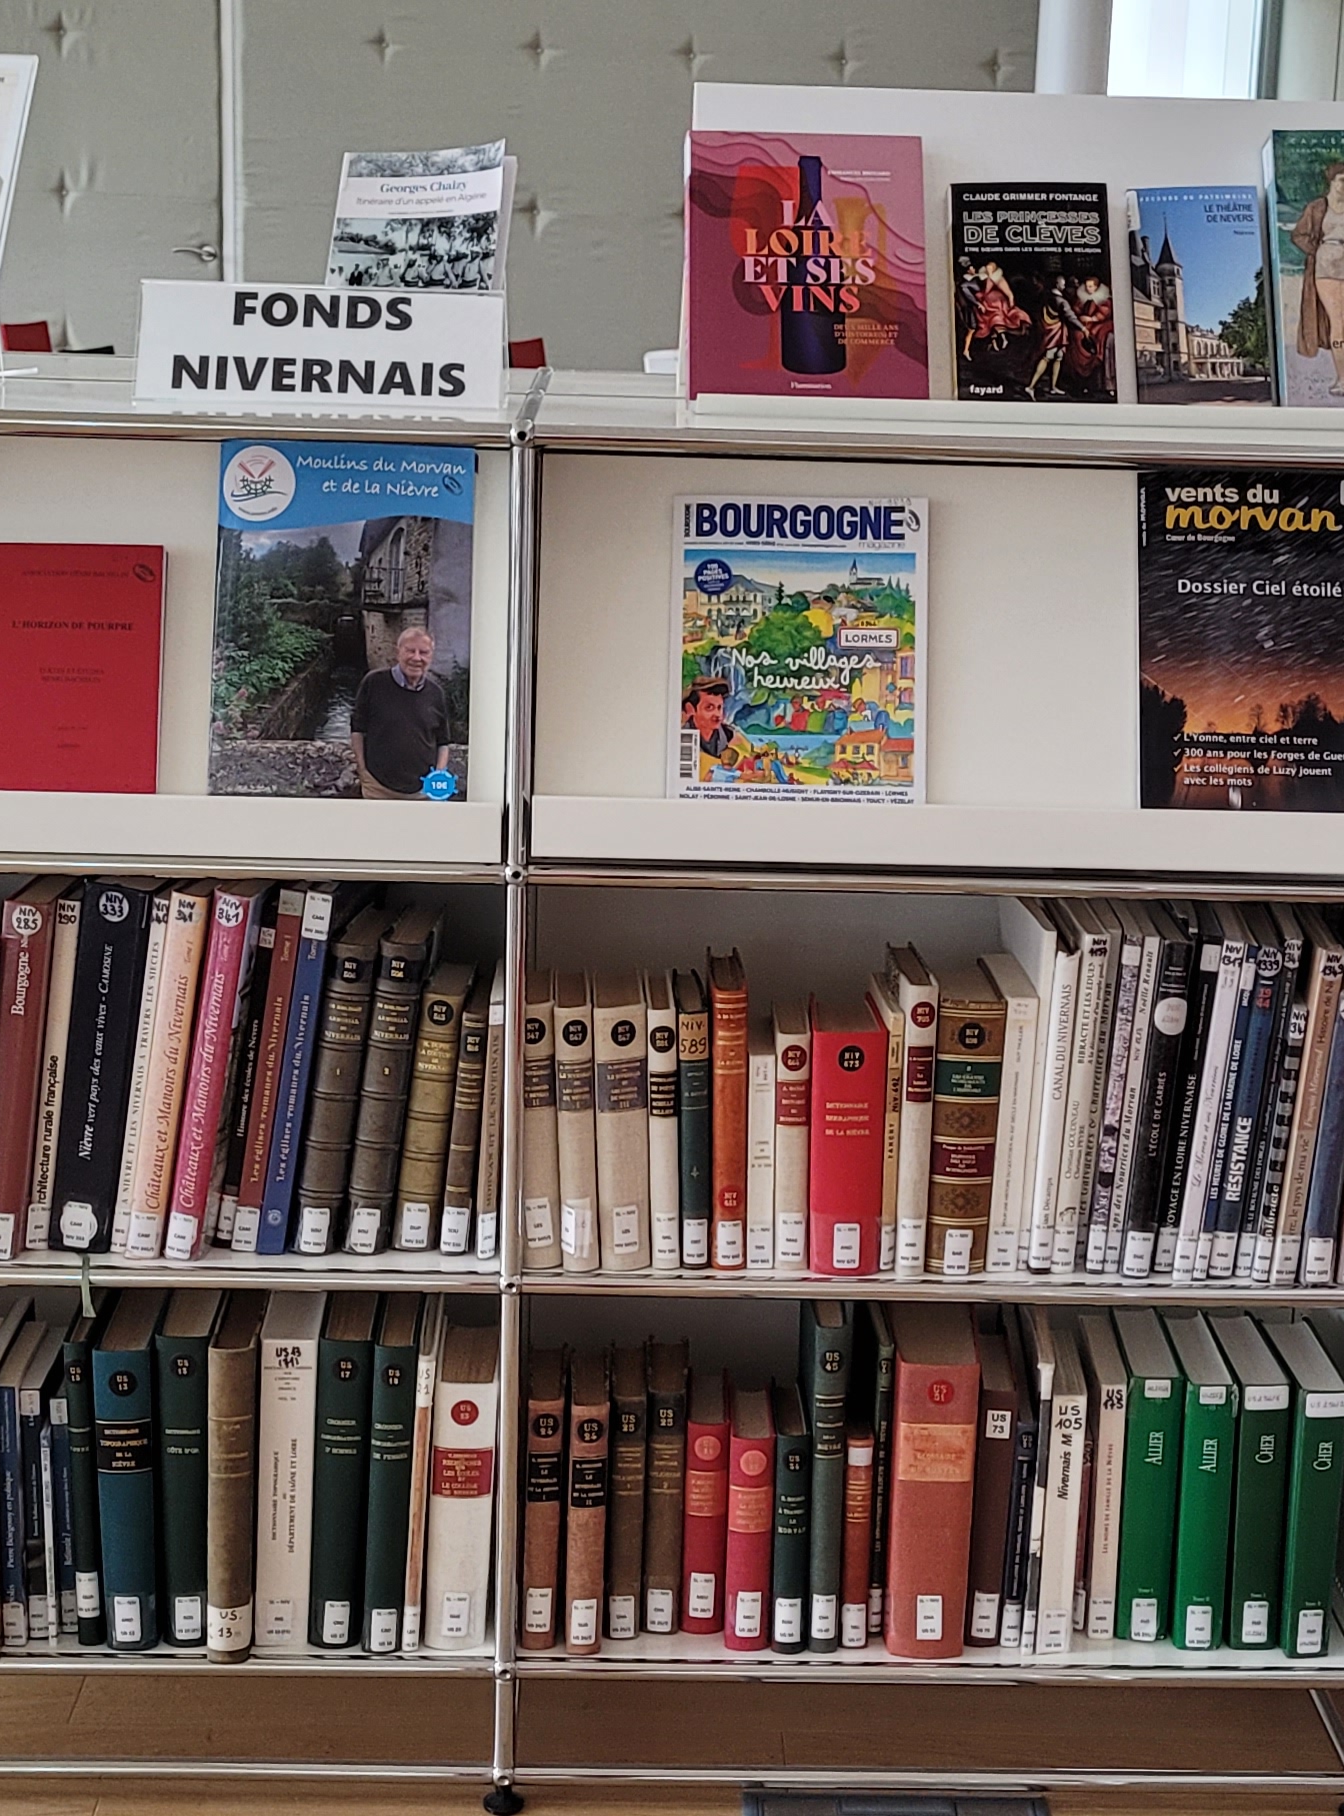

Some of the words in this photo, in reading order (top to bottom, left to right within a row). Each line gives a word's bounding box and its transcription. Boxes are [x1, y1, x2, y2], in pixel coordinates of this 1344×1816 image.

[962, 192, 1001, 202] CLAUDE
[1002, 192, 1047, 202] GRIMMER
[1049, 193, 1099, 202] FONTANGE
[781, 200, 835, 227] LA
[963, 210, 994, 224] LES
[997, 211, 1100, 225] PRINCESSES
[1204, 204, 1214, 213] LE
[1207, 214, 1217, 223] DE
[1219, 214, 1254, 223] NEVERS
[744, 228, 873, 257] LOIRE
[963, 225, 1000, 244] DE
[1005, 221, 1102, 245] CLÈVES
[742, 256, 798, 283] ET
[805, 256, 877, 285] SES
[758, 284, 862, 314] VINS
[232, 291, 414, 331] FONDS
[170, 353, 467, 398] NIVERNAIS
[969, 384, 1004, 397] fayard
[296, 454, 369, 472] Moulins
[373, 458, 396, 472] du
[400, 460, 467, 475] Morvan
[322, 480, 338, 493] et
[341, 479, 361, 494] de
[364, 480, 381, 495] la
[387, 480, 439, 498] Nièvre
[1165, 484, 1241, 503] vents
[1246, 483, 1280, 504] du
[695, 502, 906, 541] BOURGOGNE
[1165, 504, 1343, 532] morvan
[1197, 534, 1236, 544] Bourgogne
[1177, 578, 1248, 595] Dossier
[1252, 579, 1287, 596] Ciel
[1291, 579, 1343, 597] étoilé
[71, 621, 85, 630] DE
[87, 621, 134, 631] POURPRE
[845, 633, 893, 644] LORMES
[730, 647, 778, 668] Nos
[785, 646, 882, 685] villages
[1183, 732, 1227, 745] L'Yonne,
[1229, 734, 1257, 745] entre
[1258, 734, 1278, 745] ciel
[1280, 735, 1291, 745] et
[1292, 735, 1318, 746] terre
[1183, 748, 1204, 758] 300
[1206, 750, 1225, 758] ans
[1227, 750, 1251, 761] pour
[1253, 749, 1269, 760] les
[1270, 749, 1306, 762] Forges
[1308, 750, 1320, 761] de
[1183, 763, 1202, 773] Les
[1203, 762, 1255, 777] collégiens
[1257, 763, 1270, 774] de
[1272, 764, 1297, 777] Luzy
[1298, 765, 1333, 778] jouent
[1183, 777, 1207, 785] avec
[1209, 775, 1225, 786] les
[1226, 776, 1253, 787] mots
[15, 918, 38, 931] 285
[11, 951, 31, 1016] Bourgogne
[1058, 983, 1073, 1043] NIVERNAIS
[191, 1066, 211, 1125] Manoirs
[204, 971, 226, 1042] Nivernais
[679, 1038, 707, 1054] 589
[1056, 1043, 1067, 1062] DU
[1052, 1063, 1065, 1101] CANAL
[1223, 1116, 1253, 1202] RÉSISTANCE
[826, 1353, 840, 1362] US
[991, 1413, 1007, 1424] US
[1058, 1404, 1081, 1416] US
[992, 1424, 1006, 1434] 73
[1055, 1416, 1083, 1431] 105
[1144, 1431, 1164, 1465] ALLIER
[1198, 1438, 1218, 1473] ALLIER
[1255, 1434, 1275, 1464] CHER
[1313, 1441, 1333, 1471] CHER
[1057, 1450, 1072, 1500] Nivernais
